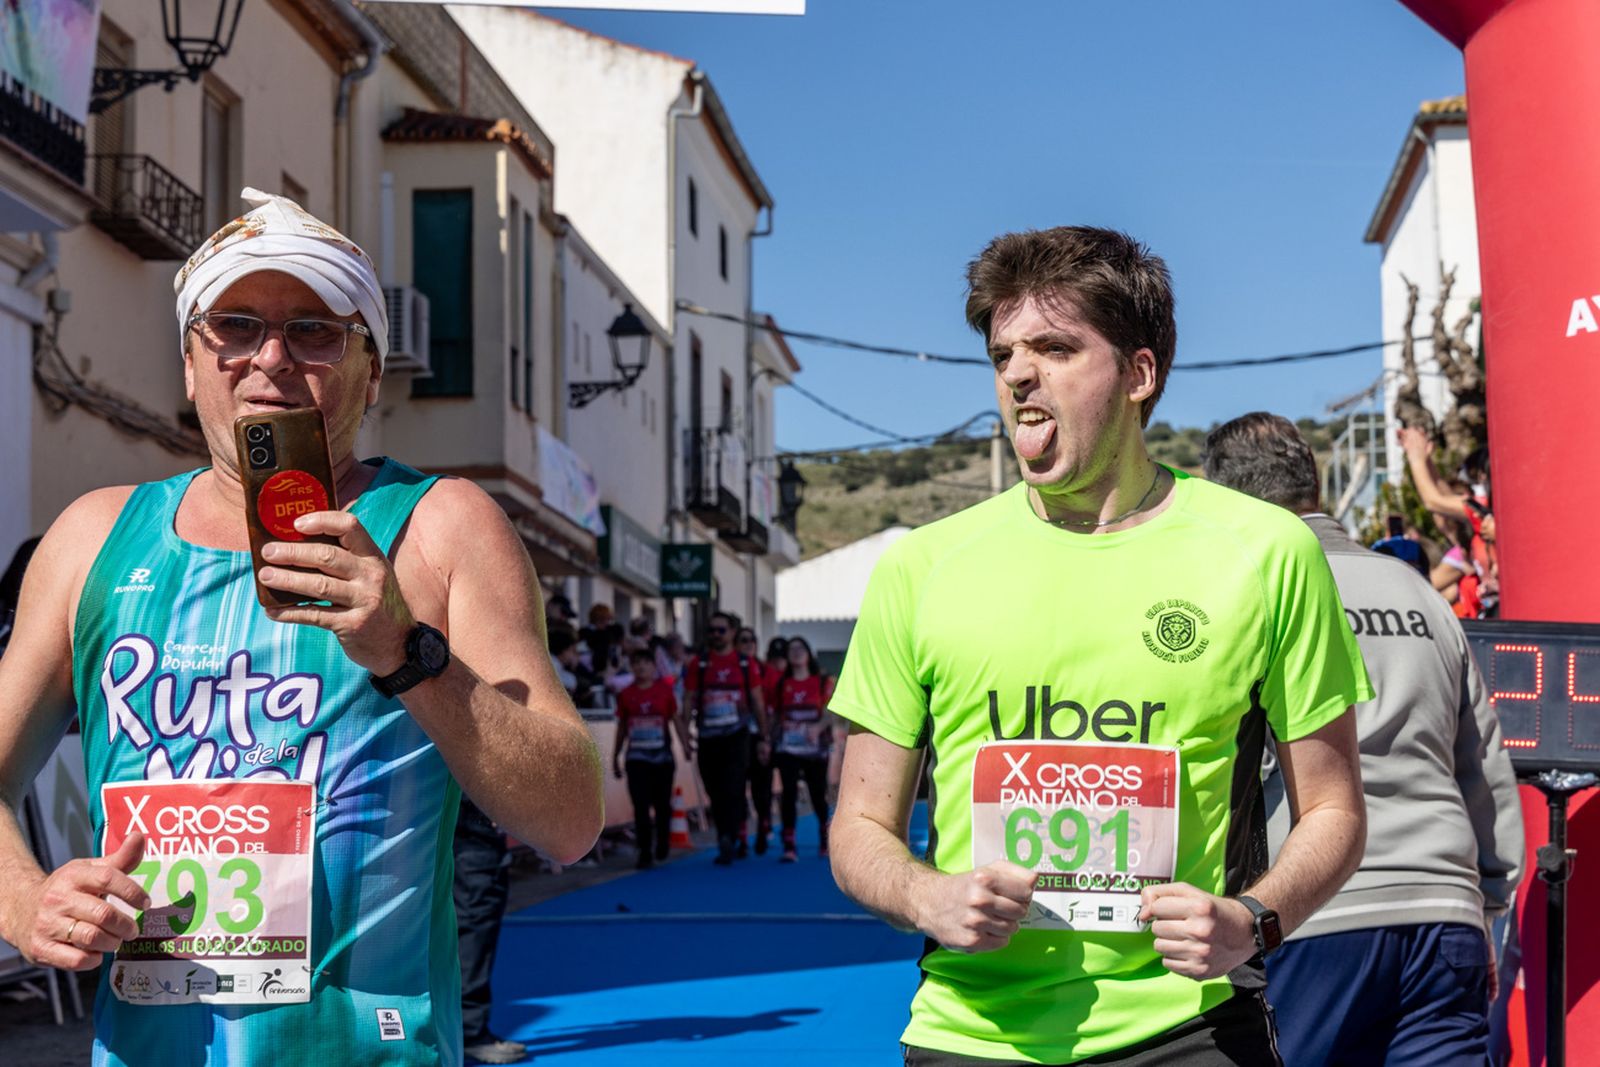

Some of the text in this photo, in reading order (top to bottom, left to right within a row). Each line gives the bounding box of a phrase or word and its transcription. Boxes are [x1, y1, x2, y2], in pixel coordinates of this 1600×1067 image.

[1565, 294, 1600, 338] A
[289, 485, 314, 497] FRS
[1343, 607, 1434, 640] oma
[161, 655, 226, 672] Popular
[163, 640, 228, 655] Carrera
[101, 633, 323, 751] Ruta
[987, 685, 1166, 744] Uber
[243, 738, 299, 766] de la
[1000, 752, 1032, 787] X
[1036, 763, 1143, 791] CROSS
[123, 794, 270, 836] X CROSS
[1000, 788, 1140, 812] PANTANO DEL
[142, 835, 269, 861] NTANO DEL
[1004, 806, 1130, 873] 691
[128, 858, 264, 935] 793
